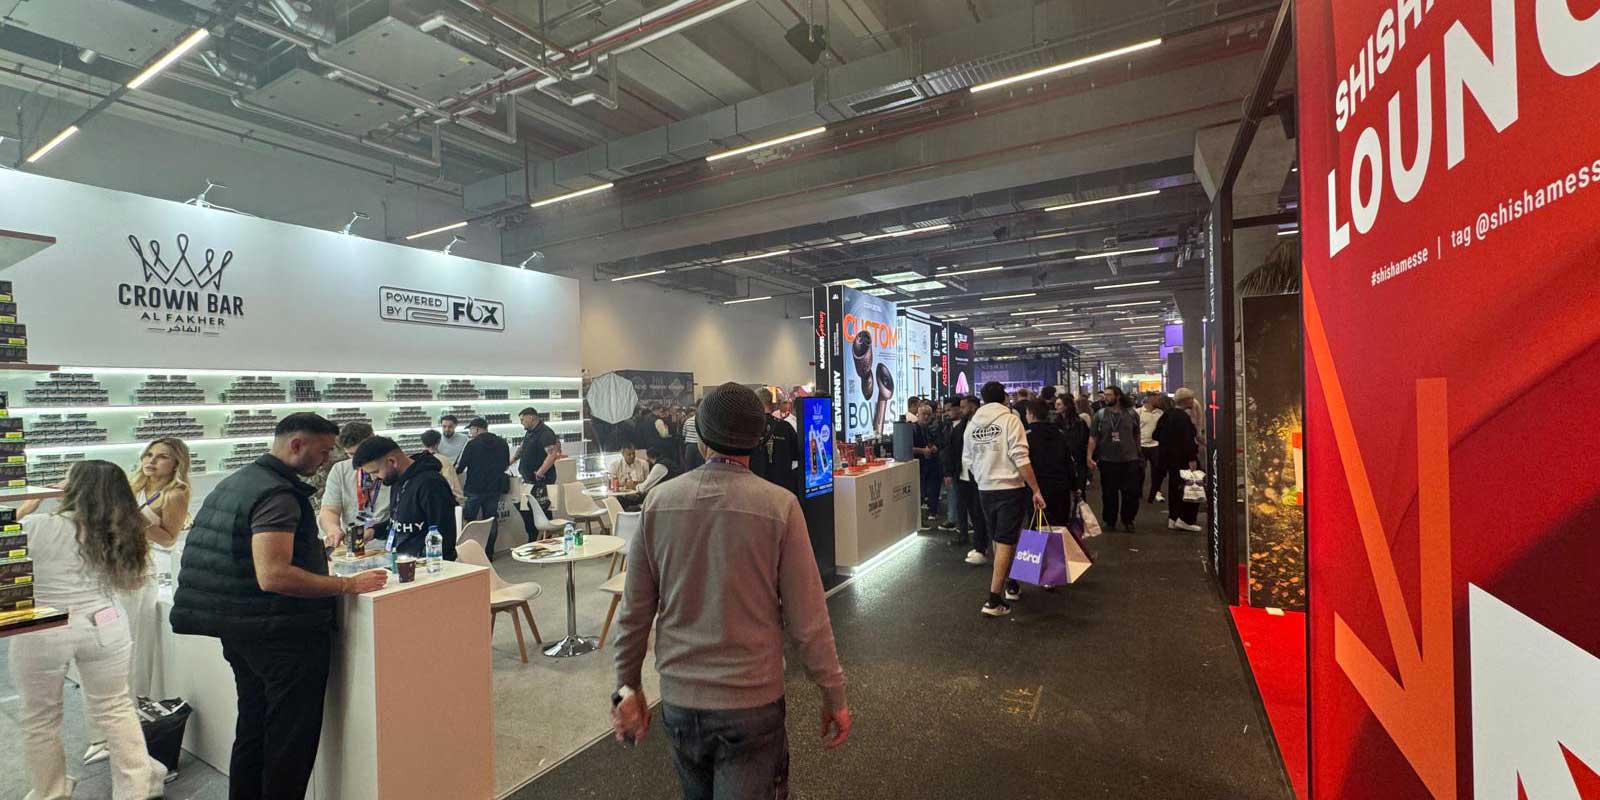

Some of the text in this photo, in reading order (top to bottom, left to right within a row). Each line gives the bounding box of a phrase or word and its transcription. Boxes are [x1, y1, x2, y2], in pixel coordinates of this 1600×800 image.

[1335, 0, 1435, 132] SHISH
[1371, 247, 1429, 287] #shishamesse
[1451, 225, 1472, 248] tag
[118, 283, 245, 316] CROWN BAR
[385, 291, 443, 308] POWERED
[386, 305, 402, 316] BY
[452, 295, 499, 326] FOX
[141, 311, 226, 326] AL FAKHER
[848, 401, 897, 430] BOS
